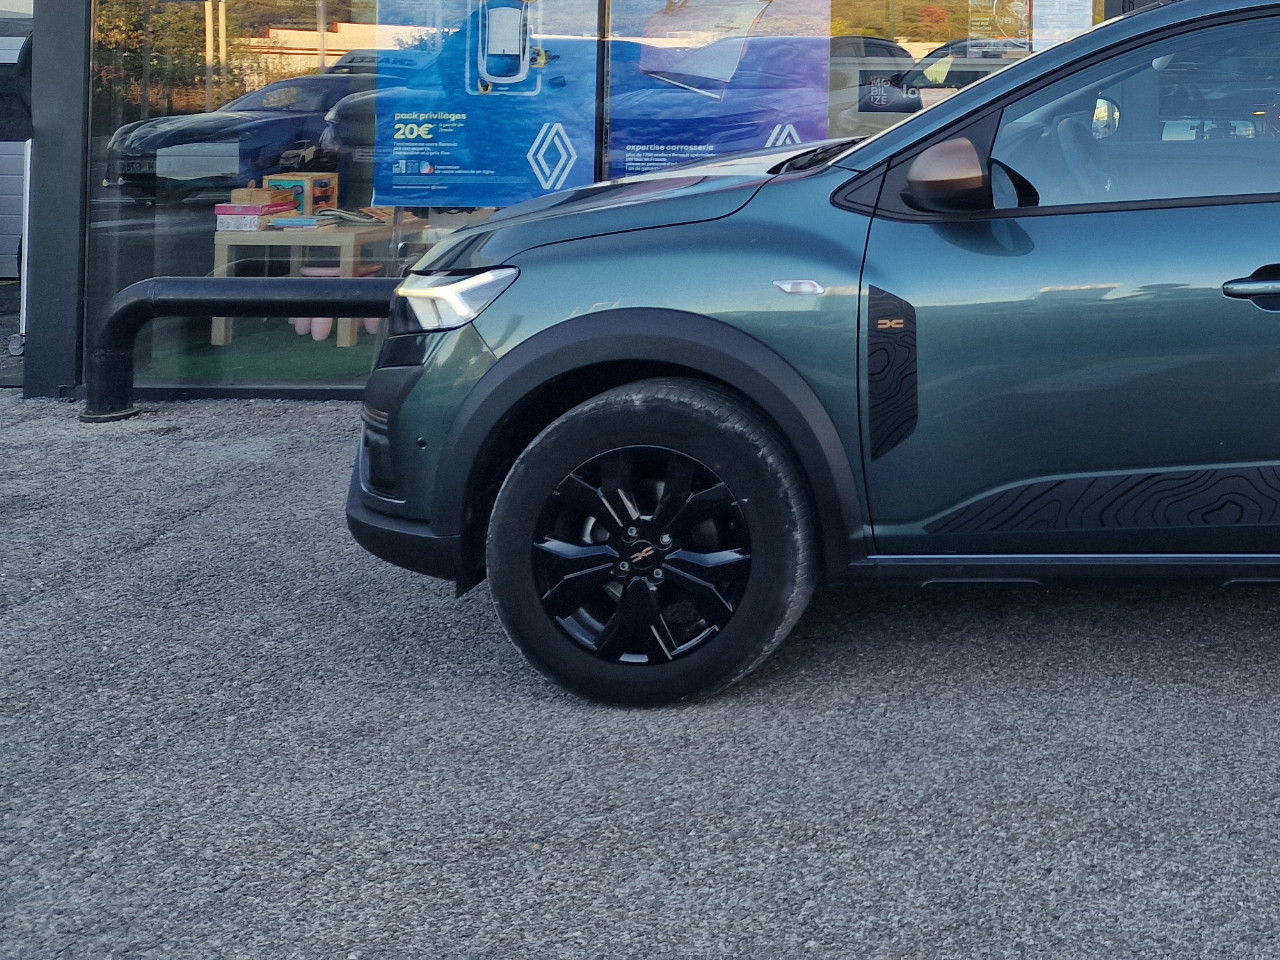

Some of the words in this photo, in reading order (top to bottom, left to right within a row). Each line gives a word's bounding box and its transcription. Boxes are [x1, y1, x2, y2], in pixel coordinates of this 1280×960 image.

[395, 112, 419, 121] pack
[420, 111, 467, 121] privilèges
[626, 144, 665, 152] expertise
[666, 143, 714, 151] carrosserie
